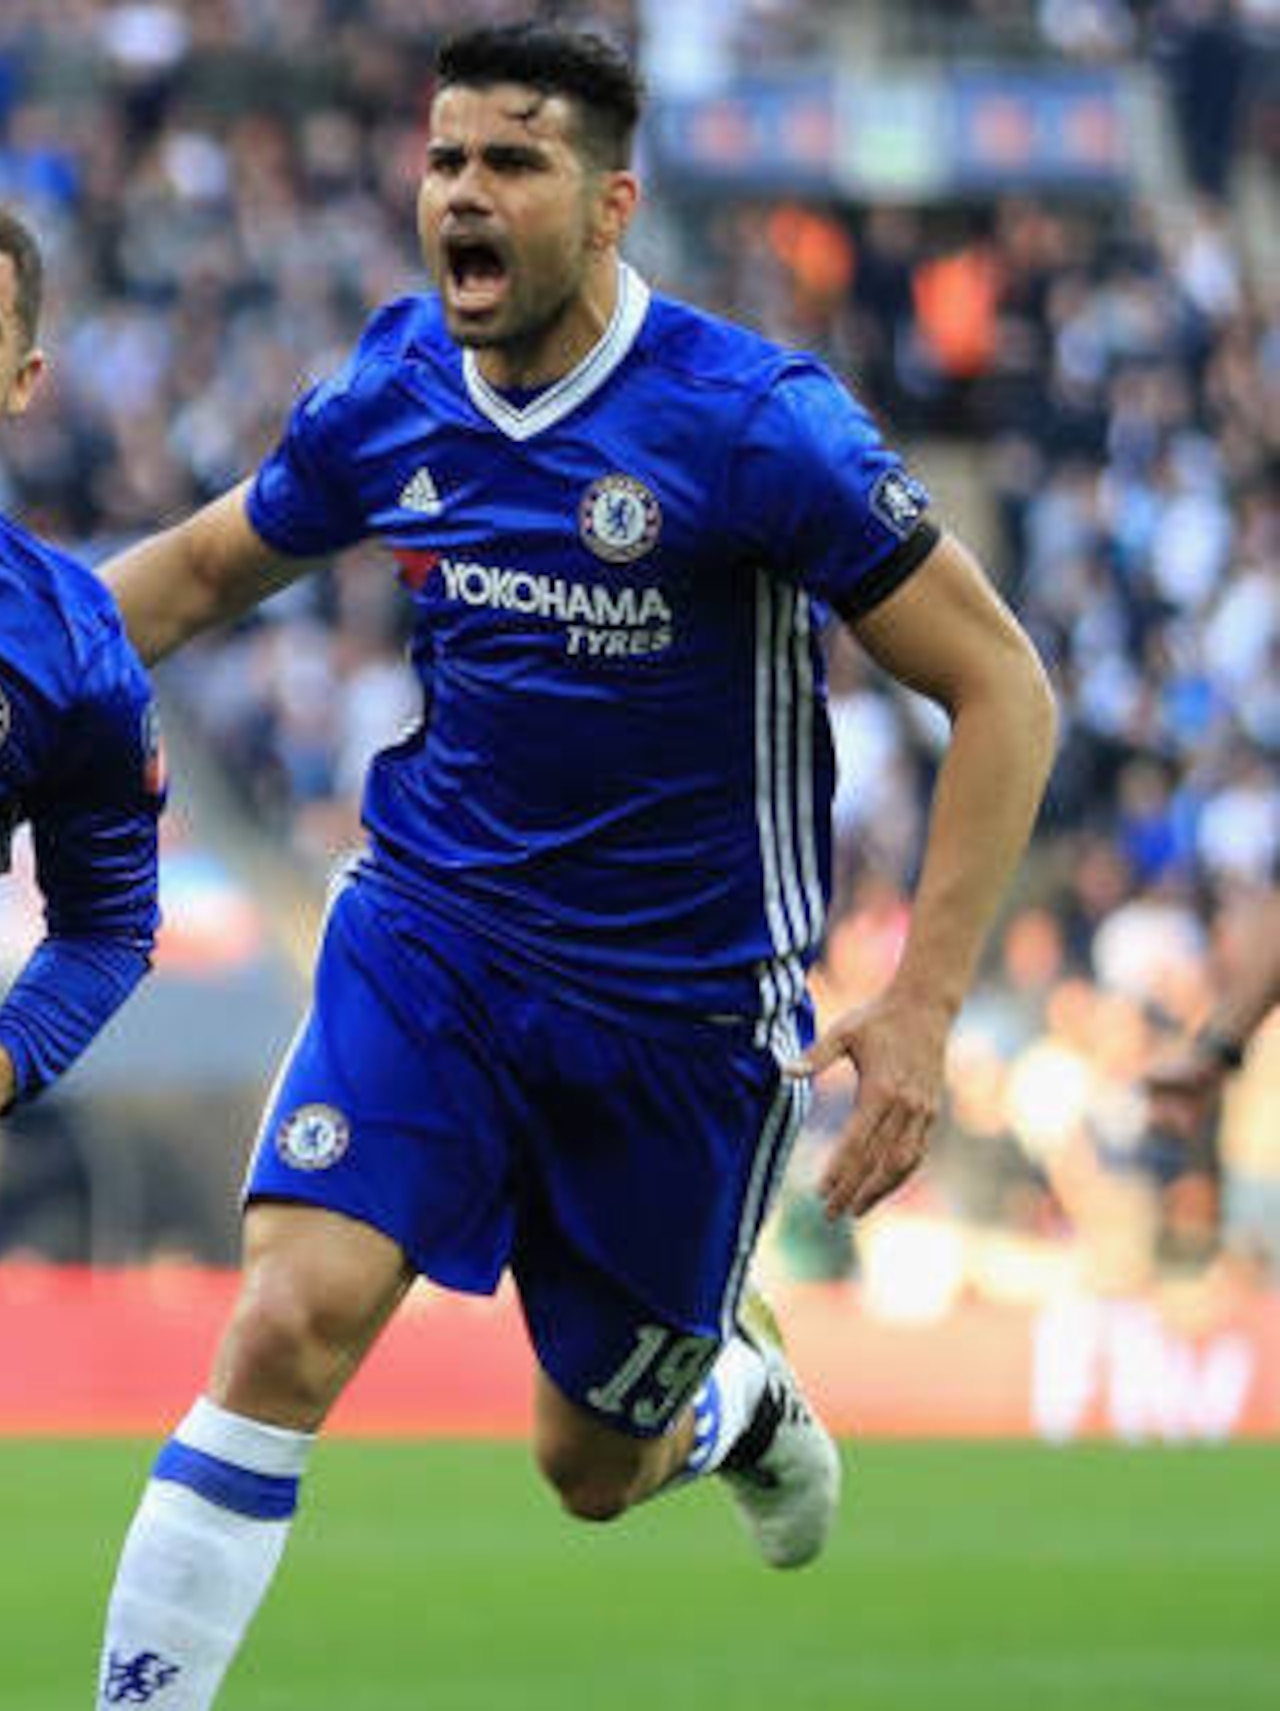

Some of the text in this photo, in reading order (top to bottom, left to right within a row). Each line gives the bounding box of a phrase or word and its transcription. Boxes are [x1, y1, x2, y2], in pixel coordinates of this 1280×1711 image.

[439, 557, 671, 626] YOKOHAMA
[566, 624, 672, 656] TYRES
[586, 1324, 716, 1427] 19
